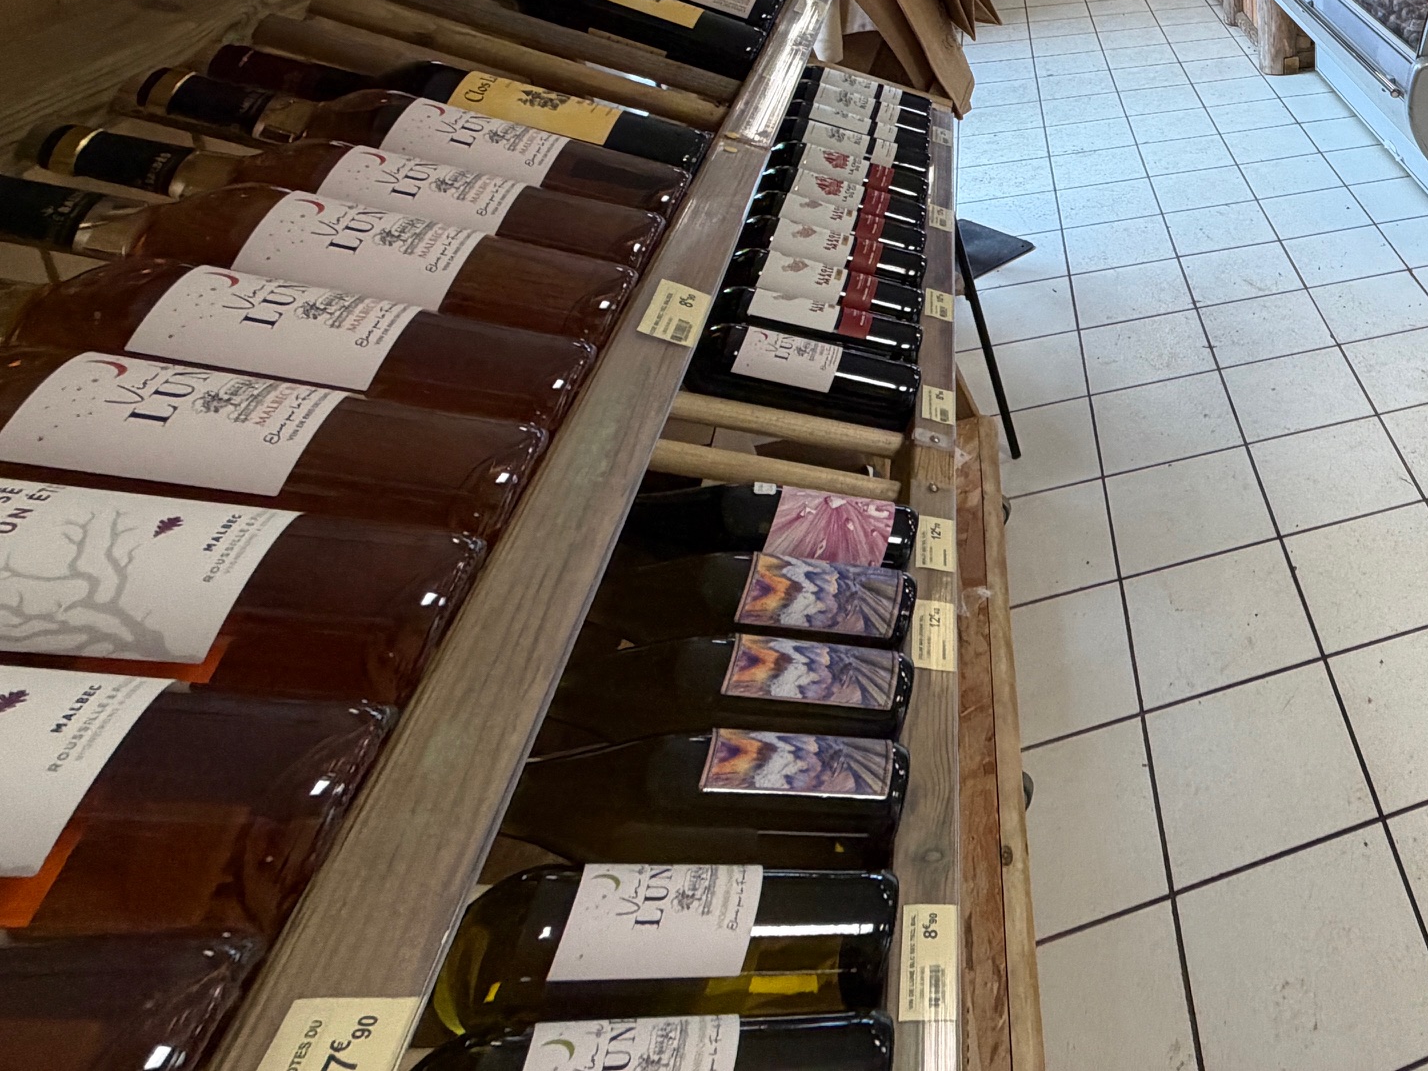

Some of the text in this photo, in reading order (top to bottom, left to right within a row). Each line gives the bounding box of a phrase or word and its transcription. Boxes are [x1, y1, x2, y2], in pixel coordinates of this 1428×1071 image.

[464, 78, 490, 102] Clos
[447, 116, 492, 148] LUN
[389, 163, 439, 200] LUN
[326, 211, 388, 255] LUN
[240, 284, 309, 329] LUN
[774, 335, 793, 361] LUN
[124, 372, 212, 427] LUN
[203, 513, 242, 552] MALBEC
[51, 684, 102, 733] MALBEC
[632, 866, 673, 930] LUN
[922, 913, 938, 939] 8€90
[304, 1019, 323, 1039] DU
[320, 1015, 379, 1071] 7€90
